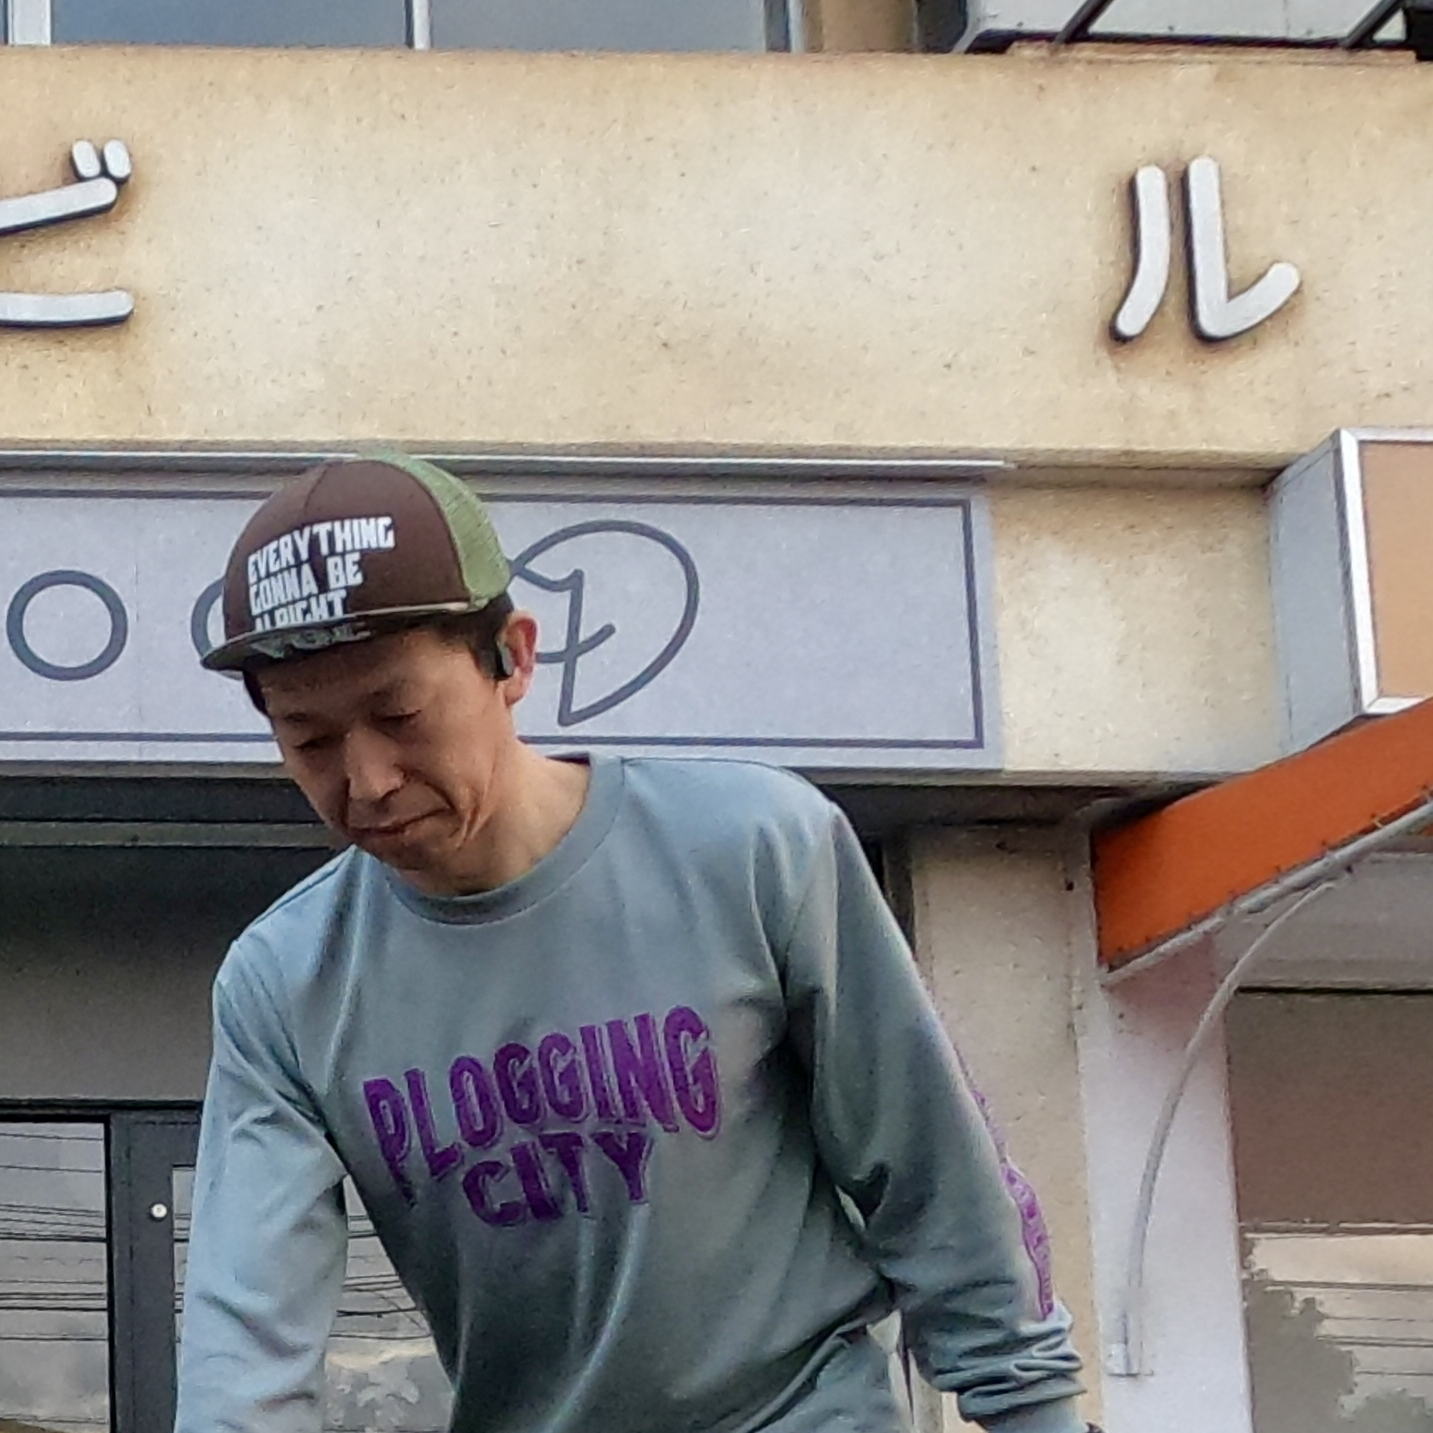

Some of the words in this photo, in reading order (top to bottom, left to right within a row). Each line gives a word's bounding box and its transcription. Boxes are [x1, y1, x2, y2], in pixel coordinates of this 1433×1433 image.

[247, 516, 395, 585] EVERYTHING
[249, 563, 318, 617] GONNA
[326, 551, 364, 590] BE
[363, 1004, 721, 1208] PLOGGING
[462, 1129, 653, 1227] CITY
